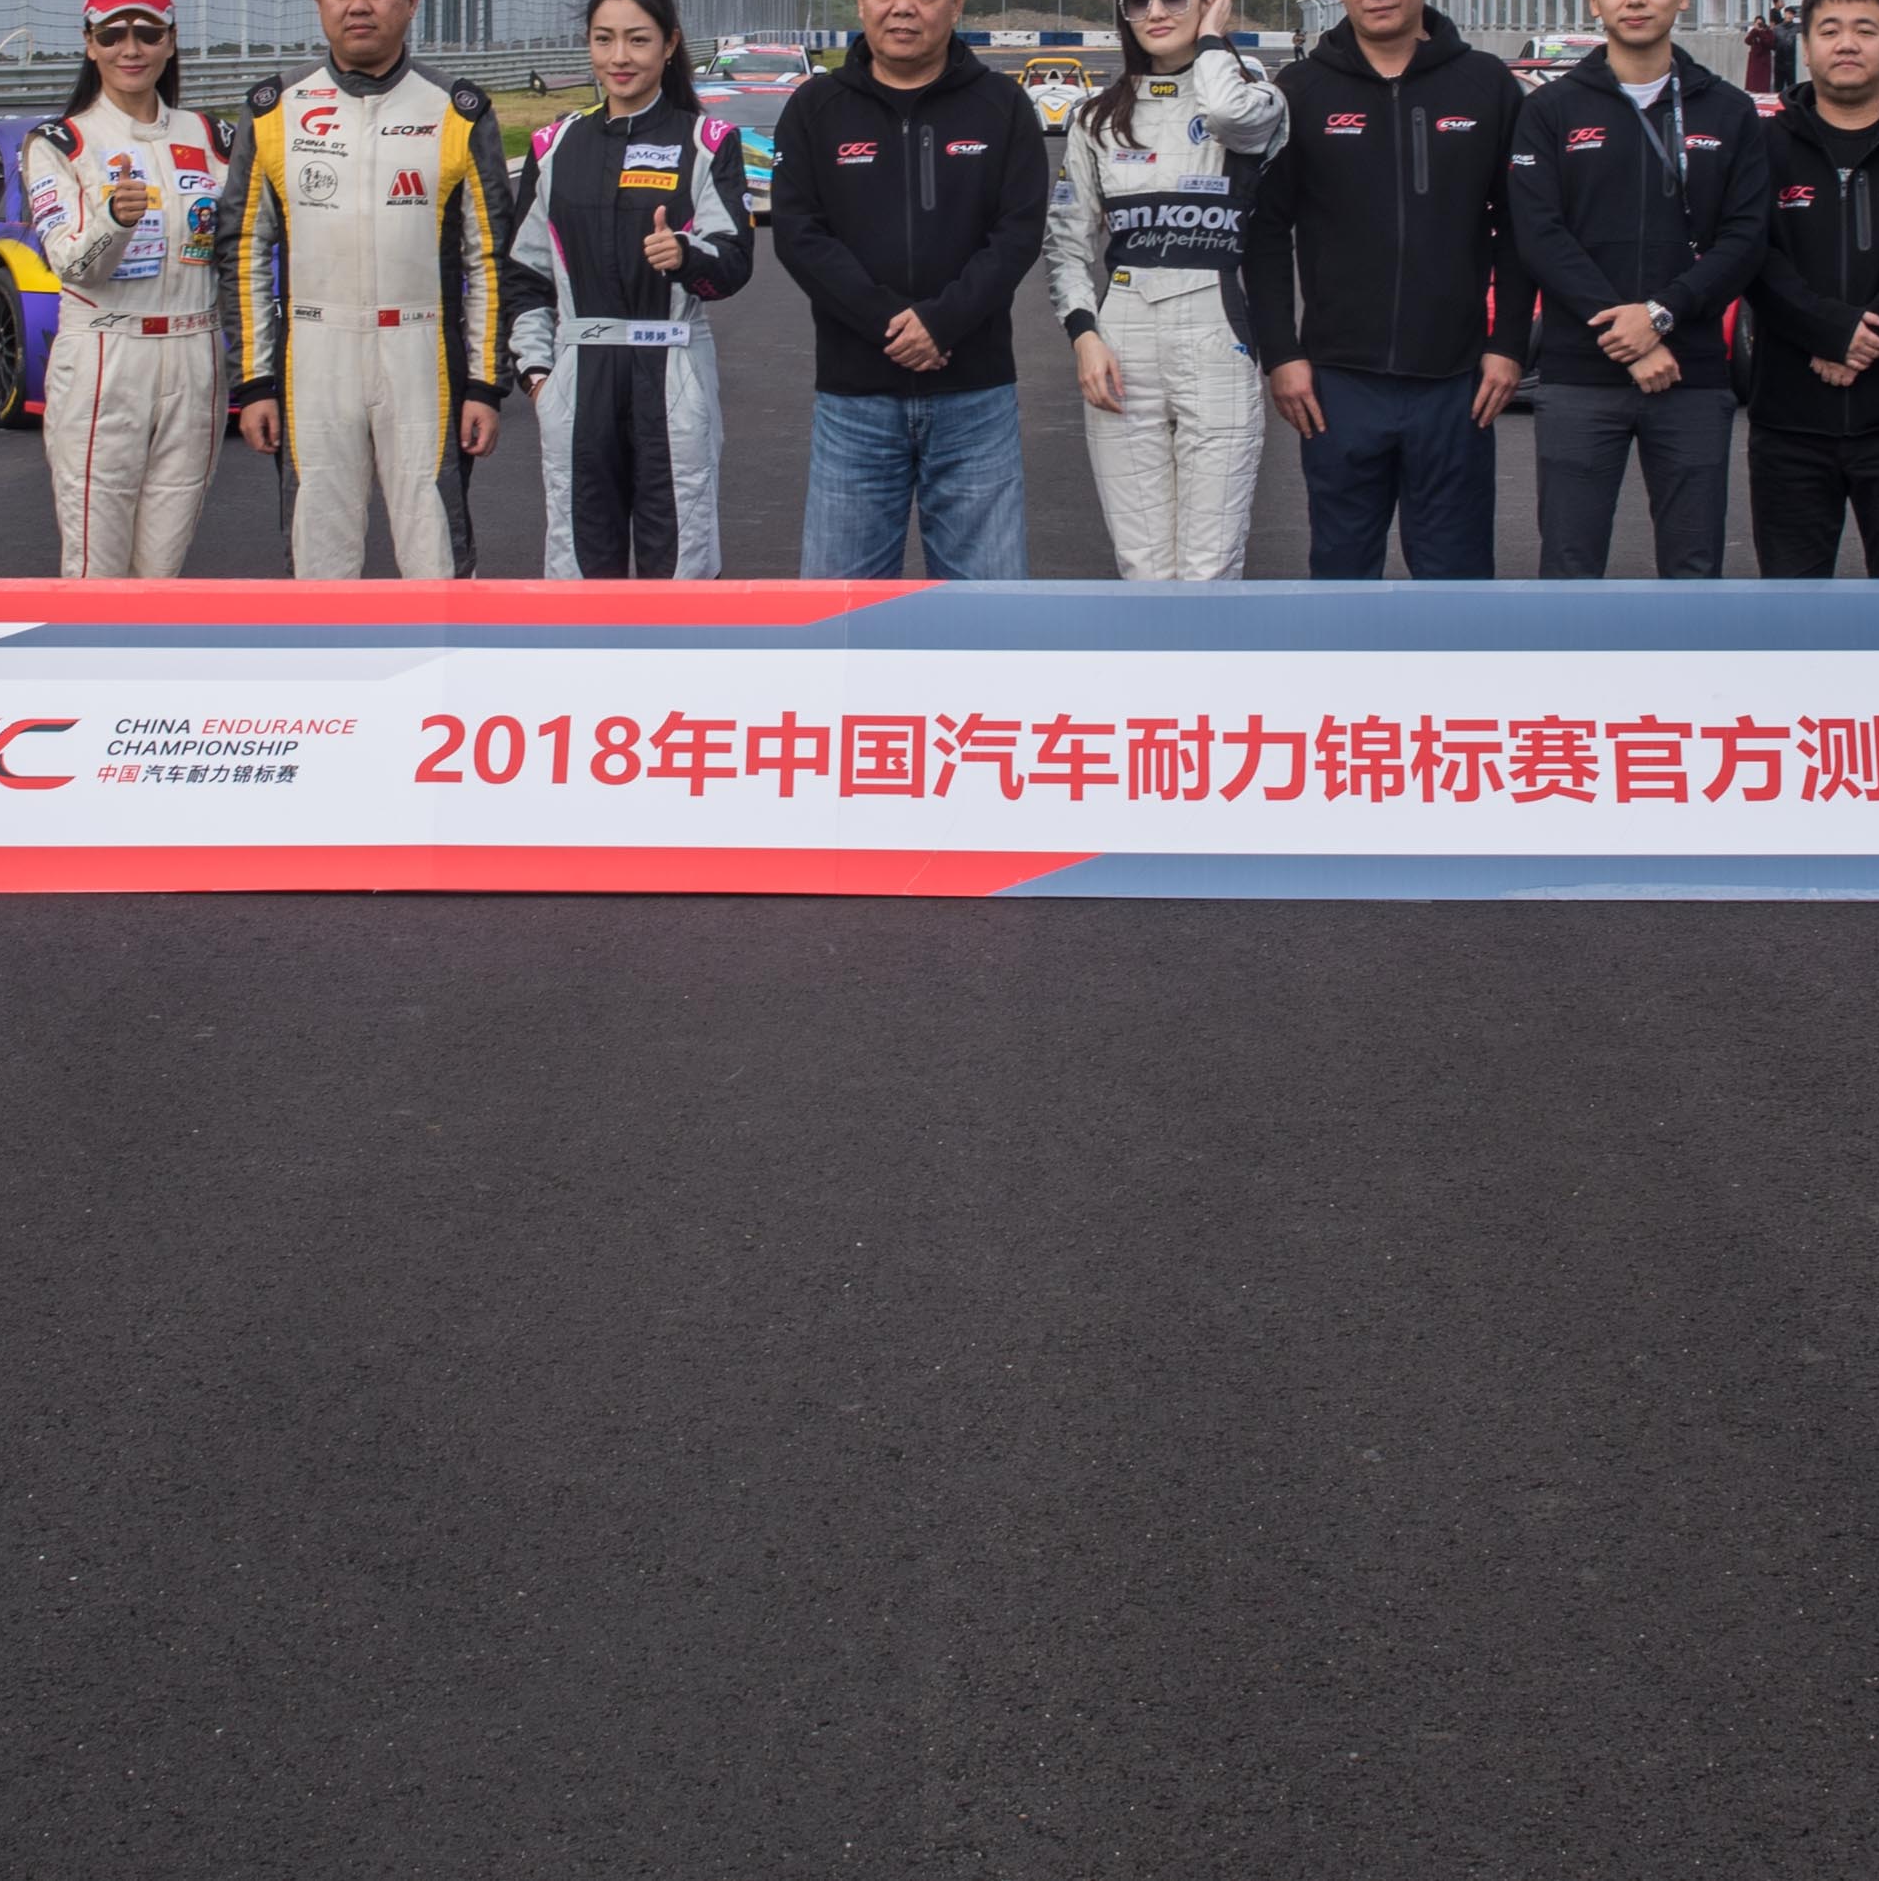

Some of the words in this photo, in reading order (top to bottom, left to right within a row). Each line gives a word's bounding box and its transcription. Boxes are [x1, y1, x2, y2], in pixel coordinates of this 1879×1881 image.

[1151, 84, 1177, 95] OMP
[115, 719, 191, 734] CHINA
[202, 719, 357, 735] ENDURANCE
[107, 740, 299, 756] CHAMPIONSHIP
[96, 764, 299, 784] 中国汽车耐力锦标赛
